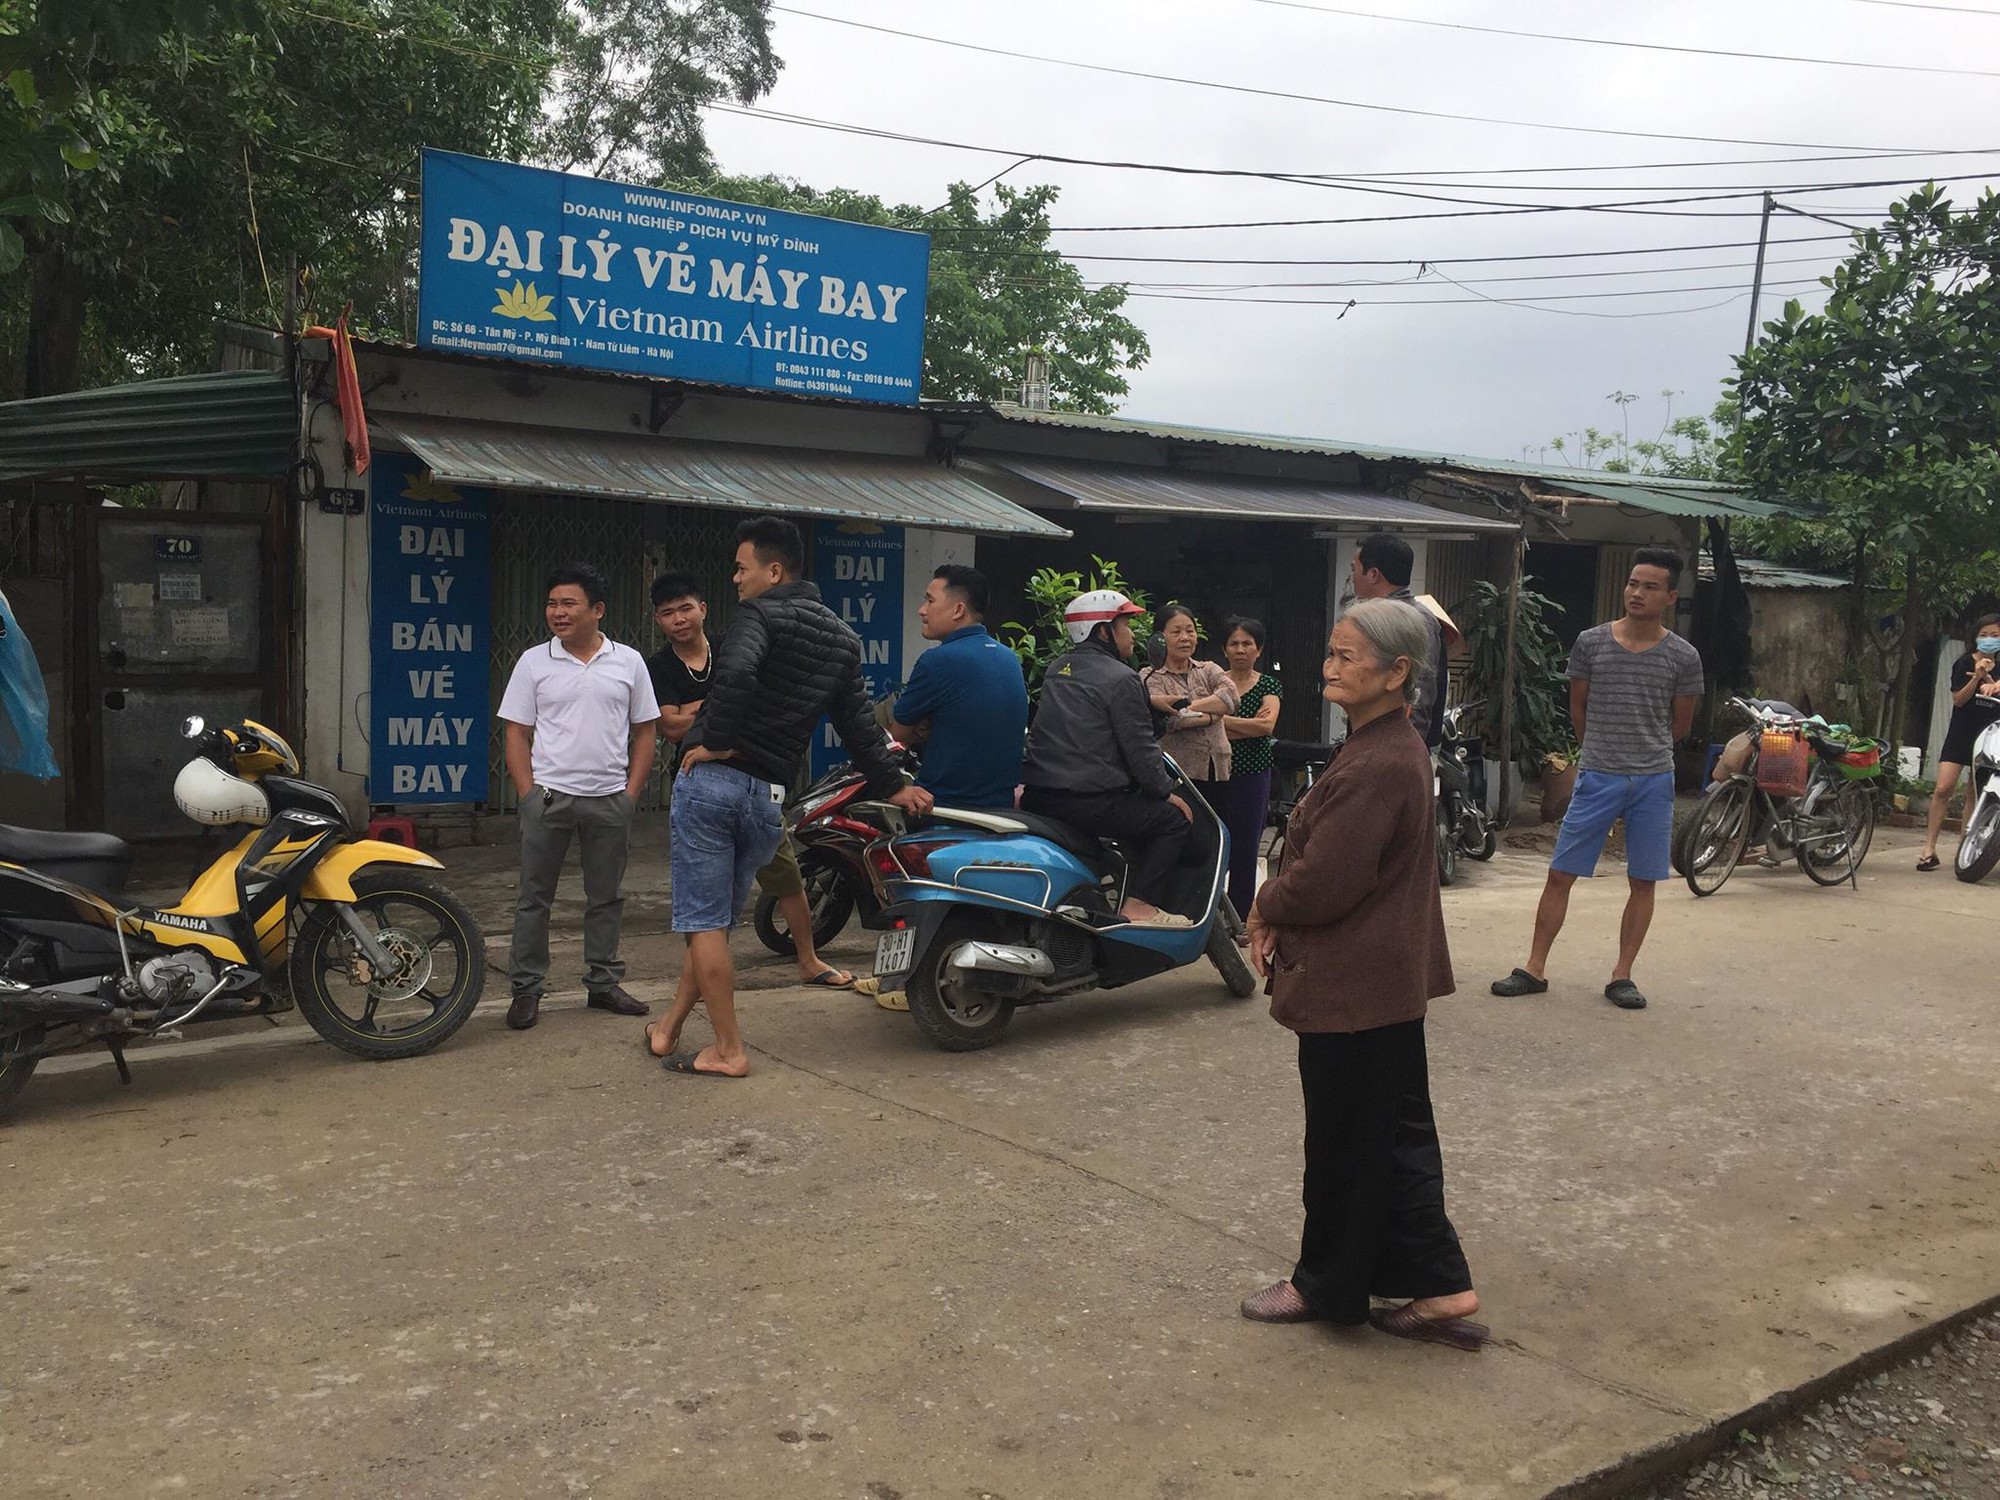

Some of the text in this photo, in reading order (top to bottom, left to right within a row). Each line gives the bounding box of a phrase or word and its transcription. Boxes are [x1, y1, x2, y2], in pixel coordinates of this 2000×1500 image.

[624, 192, 767, 226] WWW.INFOMAP.VN
[563, 202, 820, 255] DOANH NGHIỆP DỊCH VỤ MỸ ĐÌNH
[448, 217, 908, 324] ĐẠI LÝ VÉ MÁY BAY
[465, 324, 477, 335] 66
[524, 331, 534, 342] P.
[585, 339, 606, 351] Nam
[619, 342, 640, 355] Liêm
[647, 346, 658, 357] Hà
[660, 347, 674, 361] Nội
[567, 296, 868, 362] Vietnam Airlines
[775, 376, 805, 389] Hotline:
[329, 490, 355, 507] 66
[375, 503, 488, 521] Vietnam Airlines
[166, 539, 192, 553] 70
[400, 525, 465, 562] ĐẠI
[817, 535, 903, 550] Vietnam Airlines
[834, 555, 885, 586] ĐẠI
[411, 569, 455, 604] LÝ
[842, 592, 876, 623] LÝ
[392, 617, 472, 652] BÁN
[408, 664, 455, 699] VÉ
[388, 711, 474, 746] MÁY
[393, 764, 468, 794] BAY
[153, 911, 208, 931] YAMAHA
[882, 931, 909, 953] 30-H1
[880, 951, 906, 973] 1407
